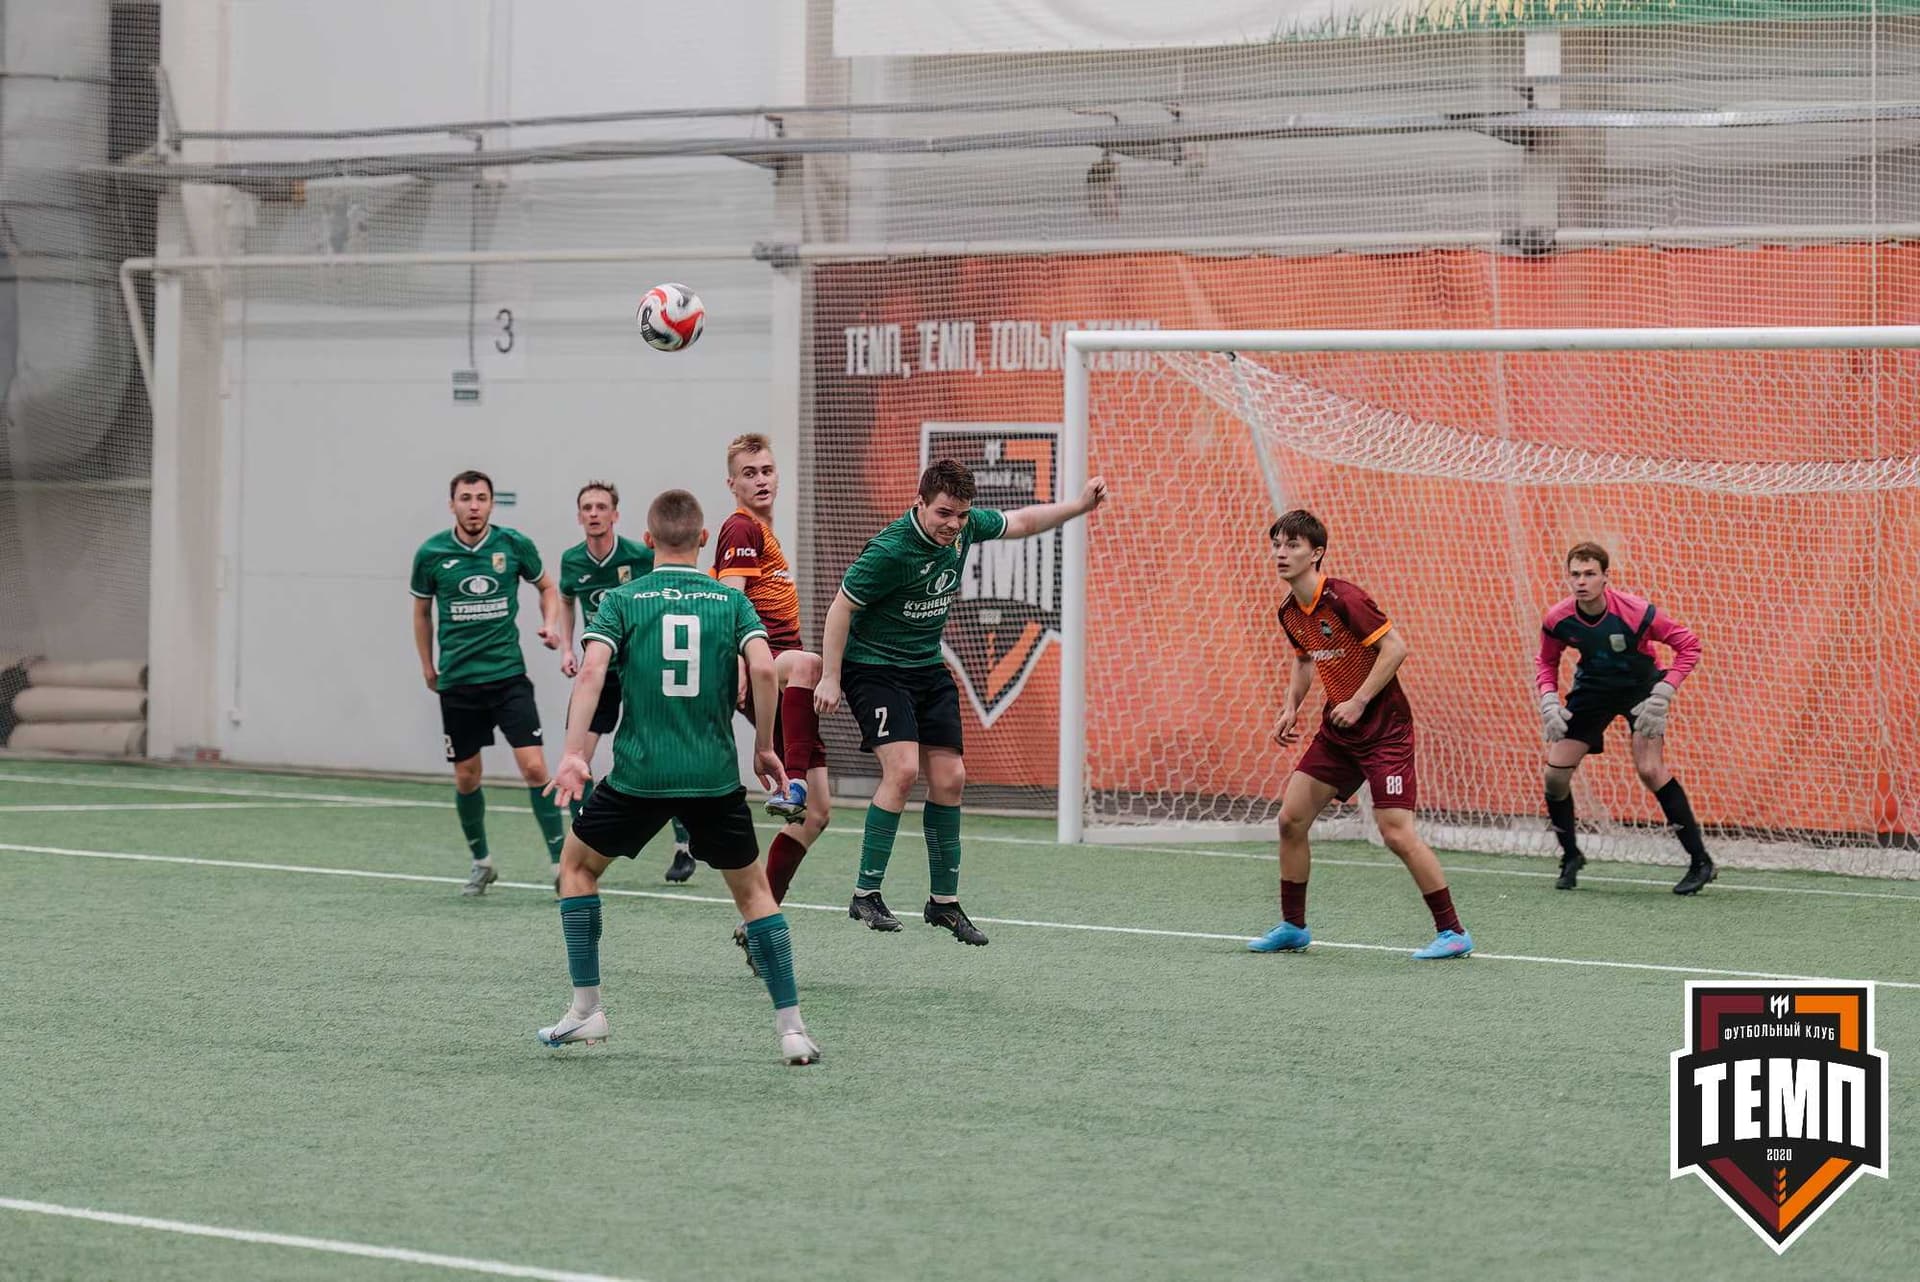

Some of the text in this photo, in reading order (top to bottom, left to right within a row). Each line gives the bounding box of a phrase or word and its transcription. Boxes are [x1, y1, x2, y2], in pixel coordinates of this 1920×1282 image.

[495, 308, 513, 354] 3
[845, 323, 911, 379] ТЕМП,
[917, 319, 984, 378] ТЕМП,
[989, 319, 1078, 371] ТОЛЬК
[736, 547, 757, 557] ПСБ
[662, 614, 700, 697] 9
[875, 706, 889, 738] 2
[1386, 775, 1403, 795] 88
